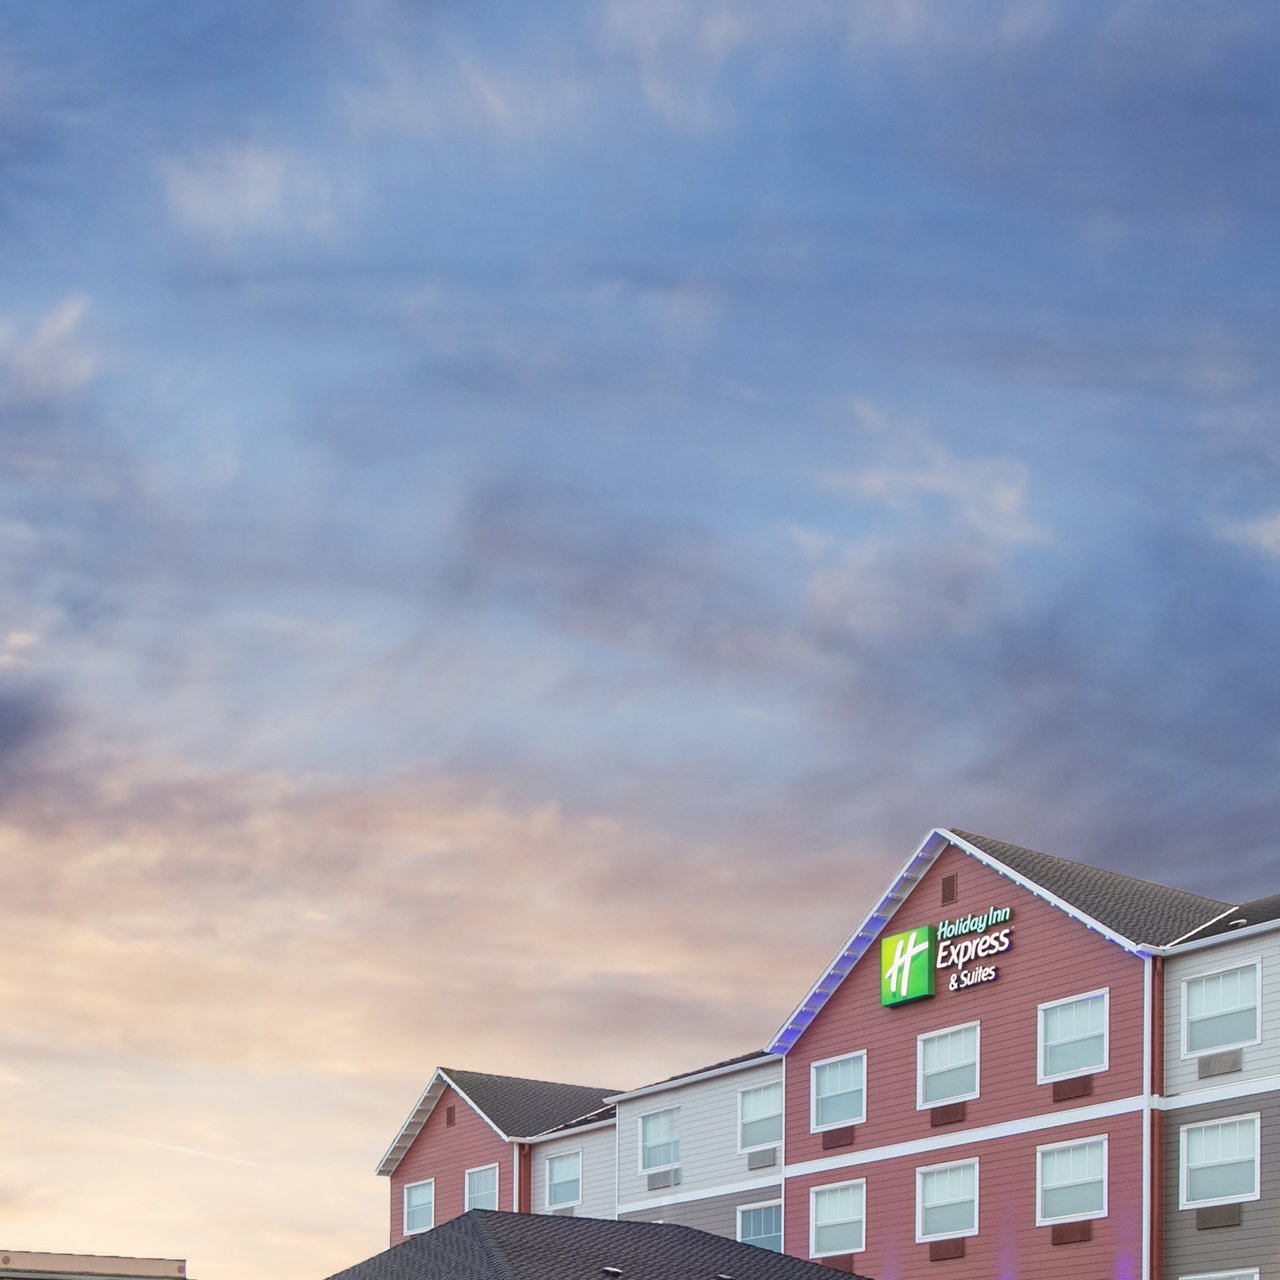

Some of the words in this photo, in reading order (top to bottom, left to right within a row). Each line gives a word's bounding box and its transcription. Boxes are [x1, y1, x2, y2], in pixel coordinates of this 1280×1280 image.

[936, 913, 988, 940] Holiday
[988, 906, 1011, 926] Inn
[936, 929, 1011, 969] Express
[948, 973, 959, 991] &
[959, 965, 996, 988] Suites
